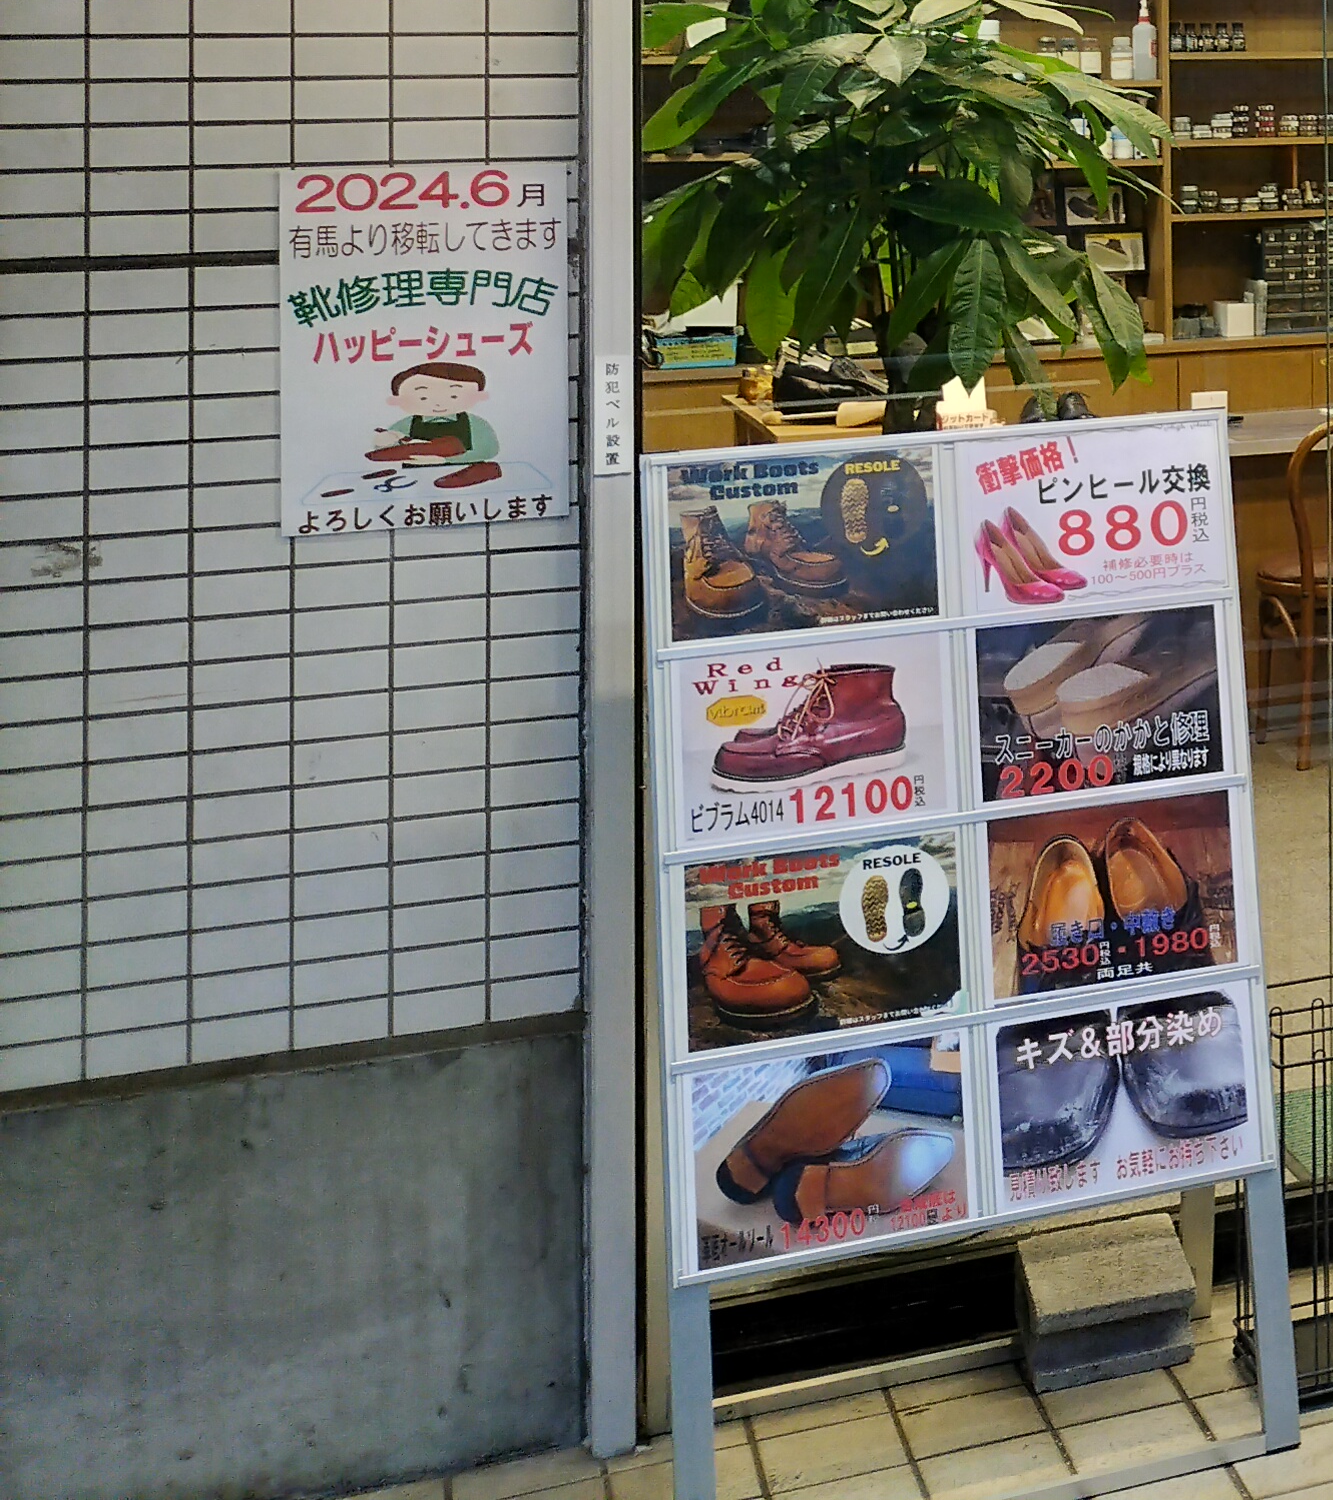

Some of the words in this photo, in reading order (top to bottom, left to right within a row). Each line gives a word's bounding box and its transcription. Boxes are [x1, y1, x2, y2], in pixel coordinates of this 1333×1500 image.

[295, 169, 546, 213] 2024.6月
[289, 217, 562, 260] 有馬より移転してきます
[288, 268, 559, 328] 靴修理専門店
[312, 321, 533, 364] ハッピーシューズ
[604, 363, 621, 466] 防犯ベル設置
[681, 462, 748, 484] Work
[754, 461, 819, 478] Boots
[845, 459, 901, 475] RESOLE
[1038, 463, 1211, 504] ピンヒール交換
[709, 480, 799, 501] Custom
[298, 494, 552, 535] よろしくお願いします
[1058, 500, 1188, 556] 880
[1190, 497, 1210, 543] 円税込
[1103, 552, 1194, 570] 補修必要時は
[994, 710, 1210, 765] スニーカーのかかと修理
[1000, 754, 1114, 799] 2200
[691, 798, 785, 834] ビブラム4014
[789, 775, 913, 824] 12100
[700, 860, 768, 885] Work
[773, 852, 841, 875] Boots
[862, 852, 922, 871] RESOLE
[728, 875, 819, 900] Custom
[1021, 944, 1099, 976] 2530
[1096, 961, 1153, 980] 両足共
[1116, 1134, 1243, 1180] お気軽にお持ち下さい
[780, 1208, 866, 1250] 14300
